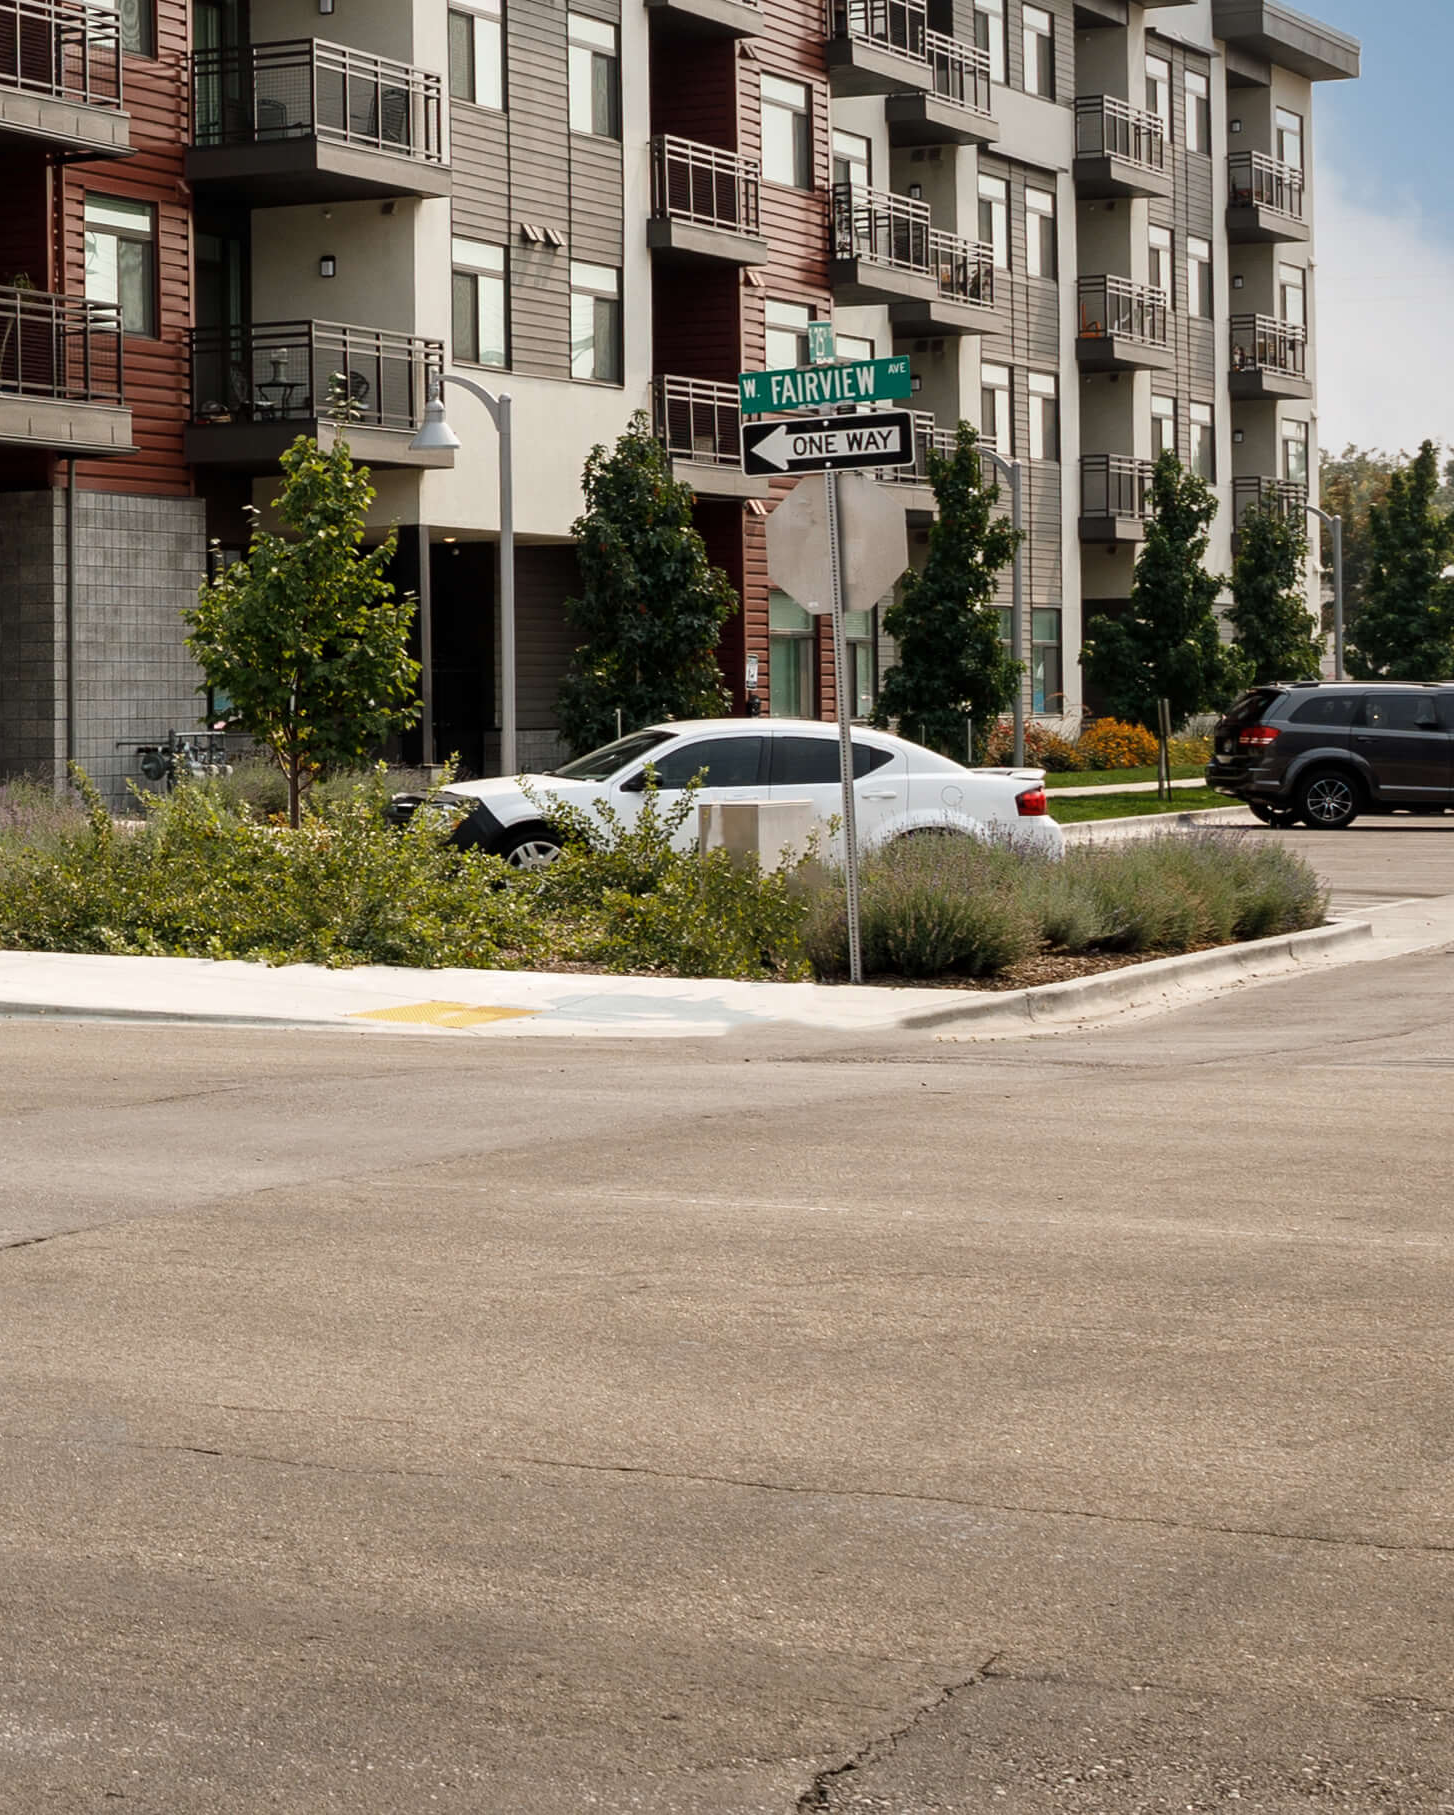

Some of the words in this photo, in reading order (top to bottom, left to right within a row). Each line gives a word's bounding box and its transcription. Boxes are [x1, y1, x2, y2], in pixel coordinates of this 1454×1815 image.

[742, 378, 761, 399] W.
[770, 366, 875, 405] FAIRVIEW
[888, 362, 906, 374] AVE
[793, 434, 838, 456] ONE
[845, 430, 893, 452] WAY
